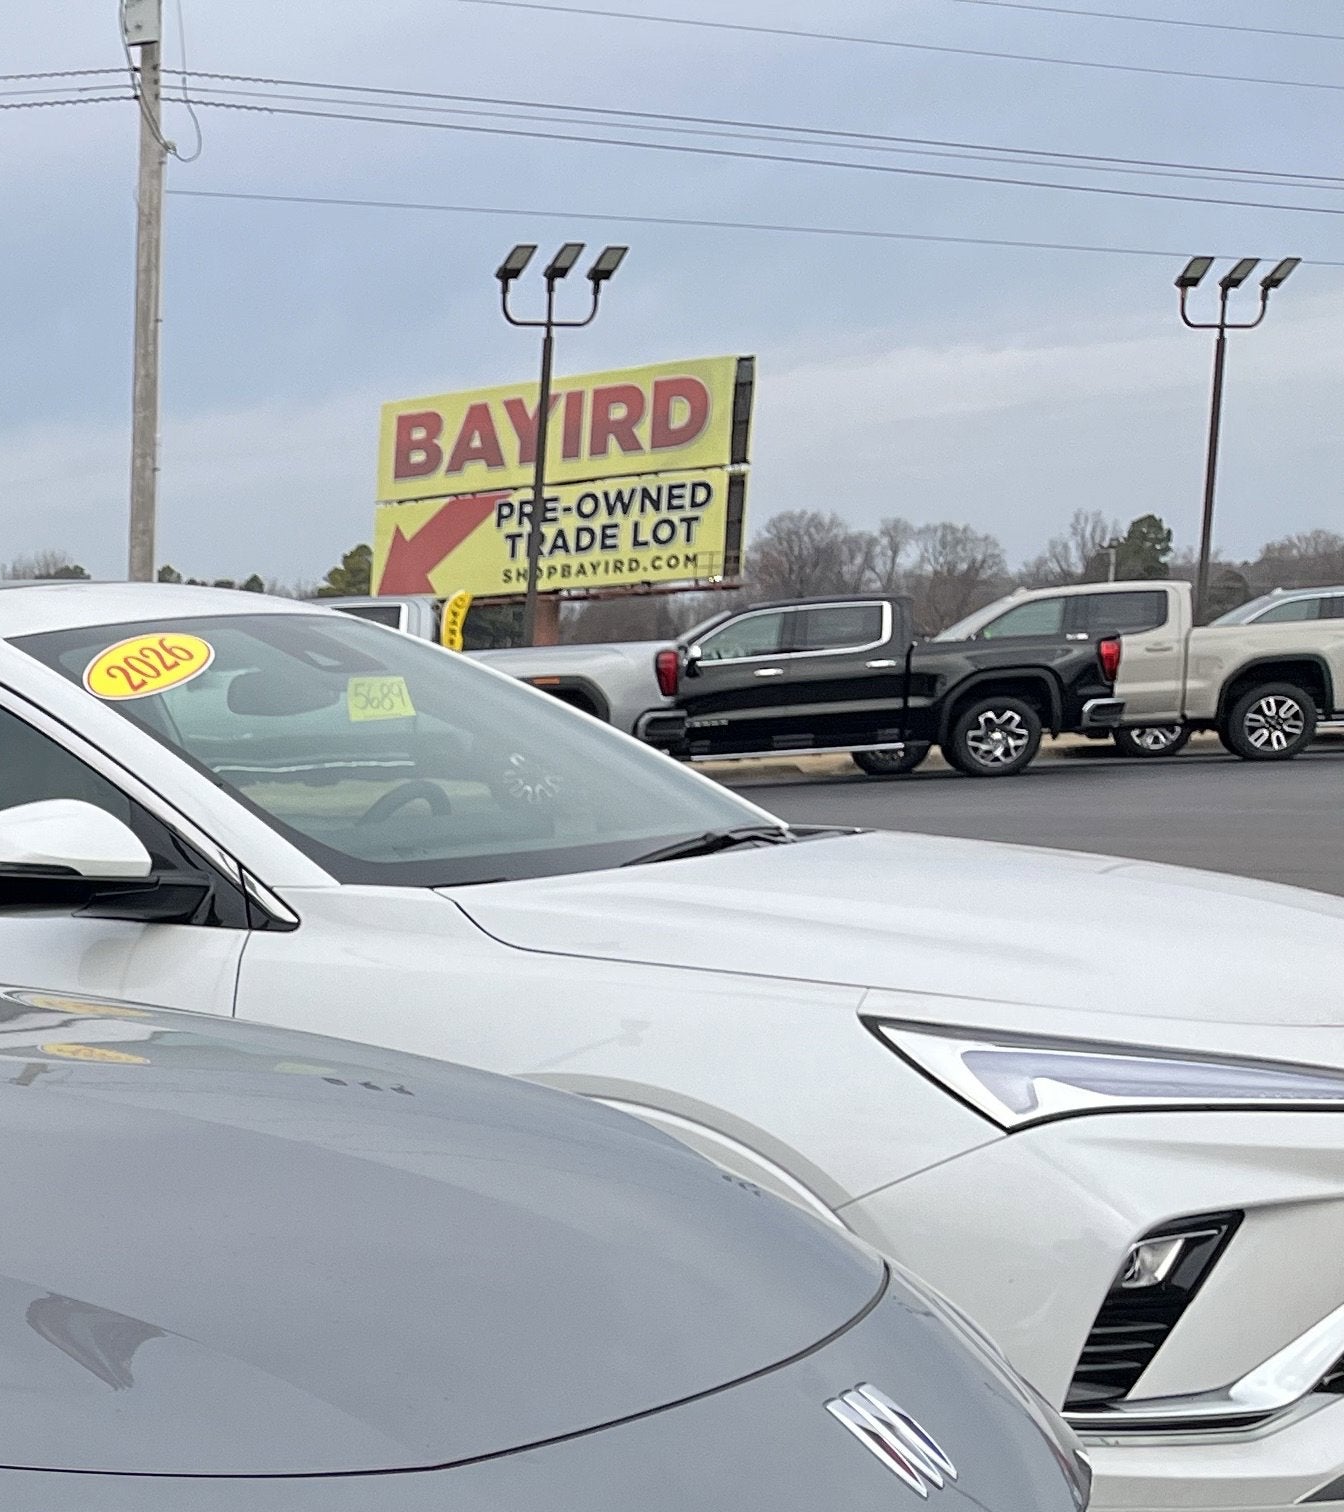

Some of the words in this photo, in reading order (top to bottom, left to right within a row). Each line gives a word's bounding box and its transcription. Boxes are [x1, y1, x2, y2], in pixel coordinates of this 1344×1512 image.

[393, 375, 711, 480] BAYIRD
[495, 481, 712, 528] PRE-OWNED
[505, 523, 620, 559] TRADE
[631, 516, 700, 548] LOT
[106, 638, 194, 692] 2026
[352, 682, 407, 711] 5689
